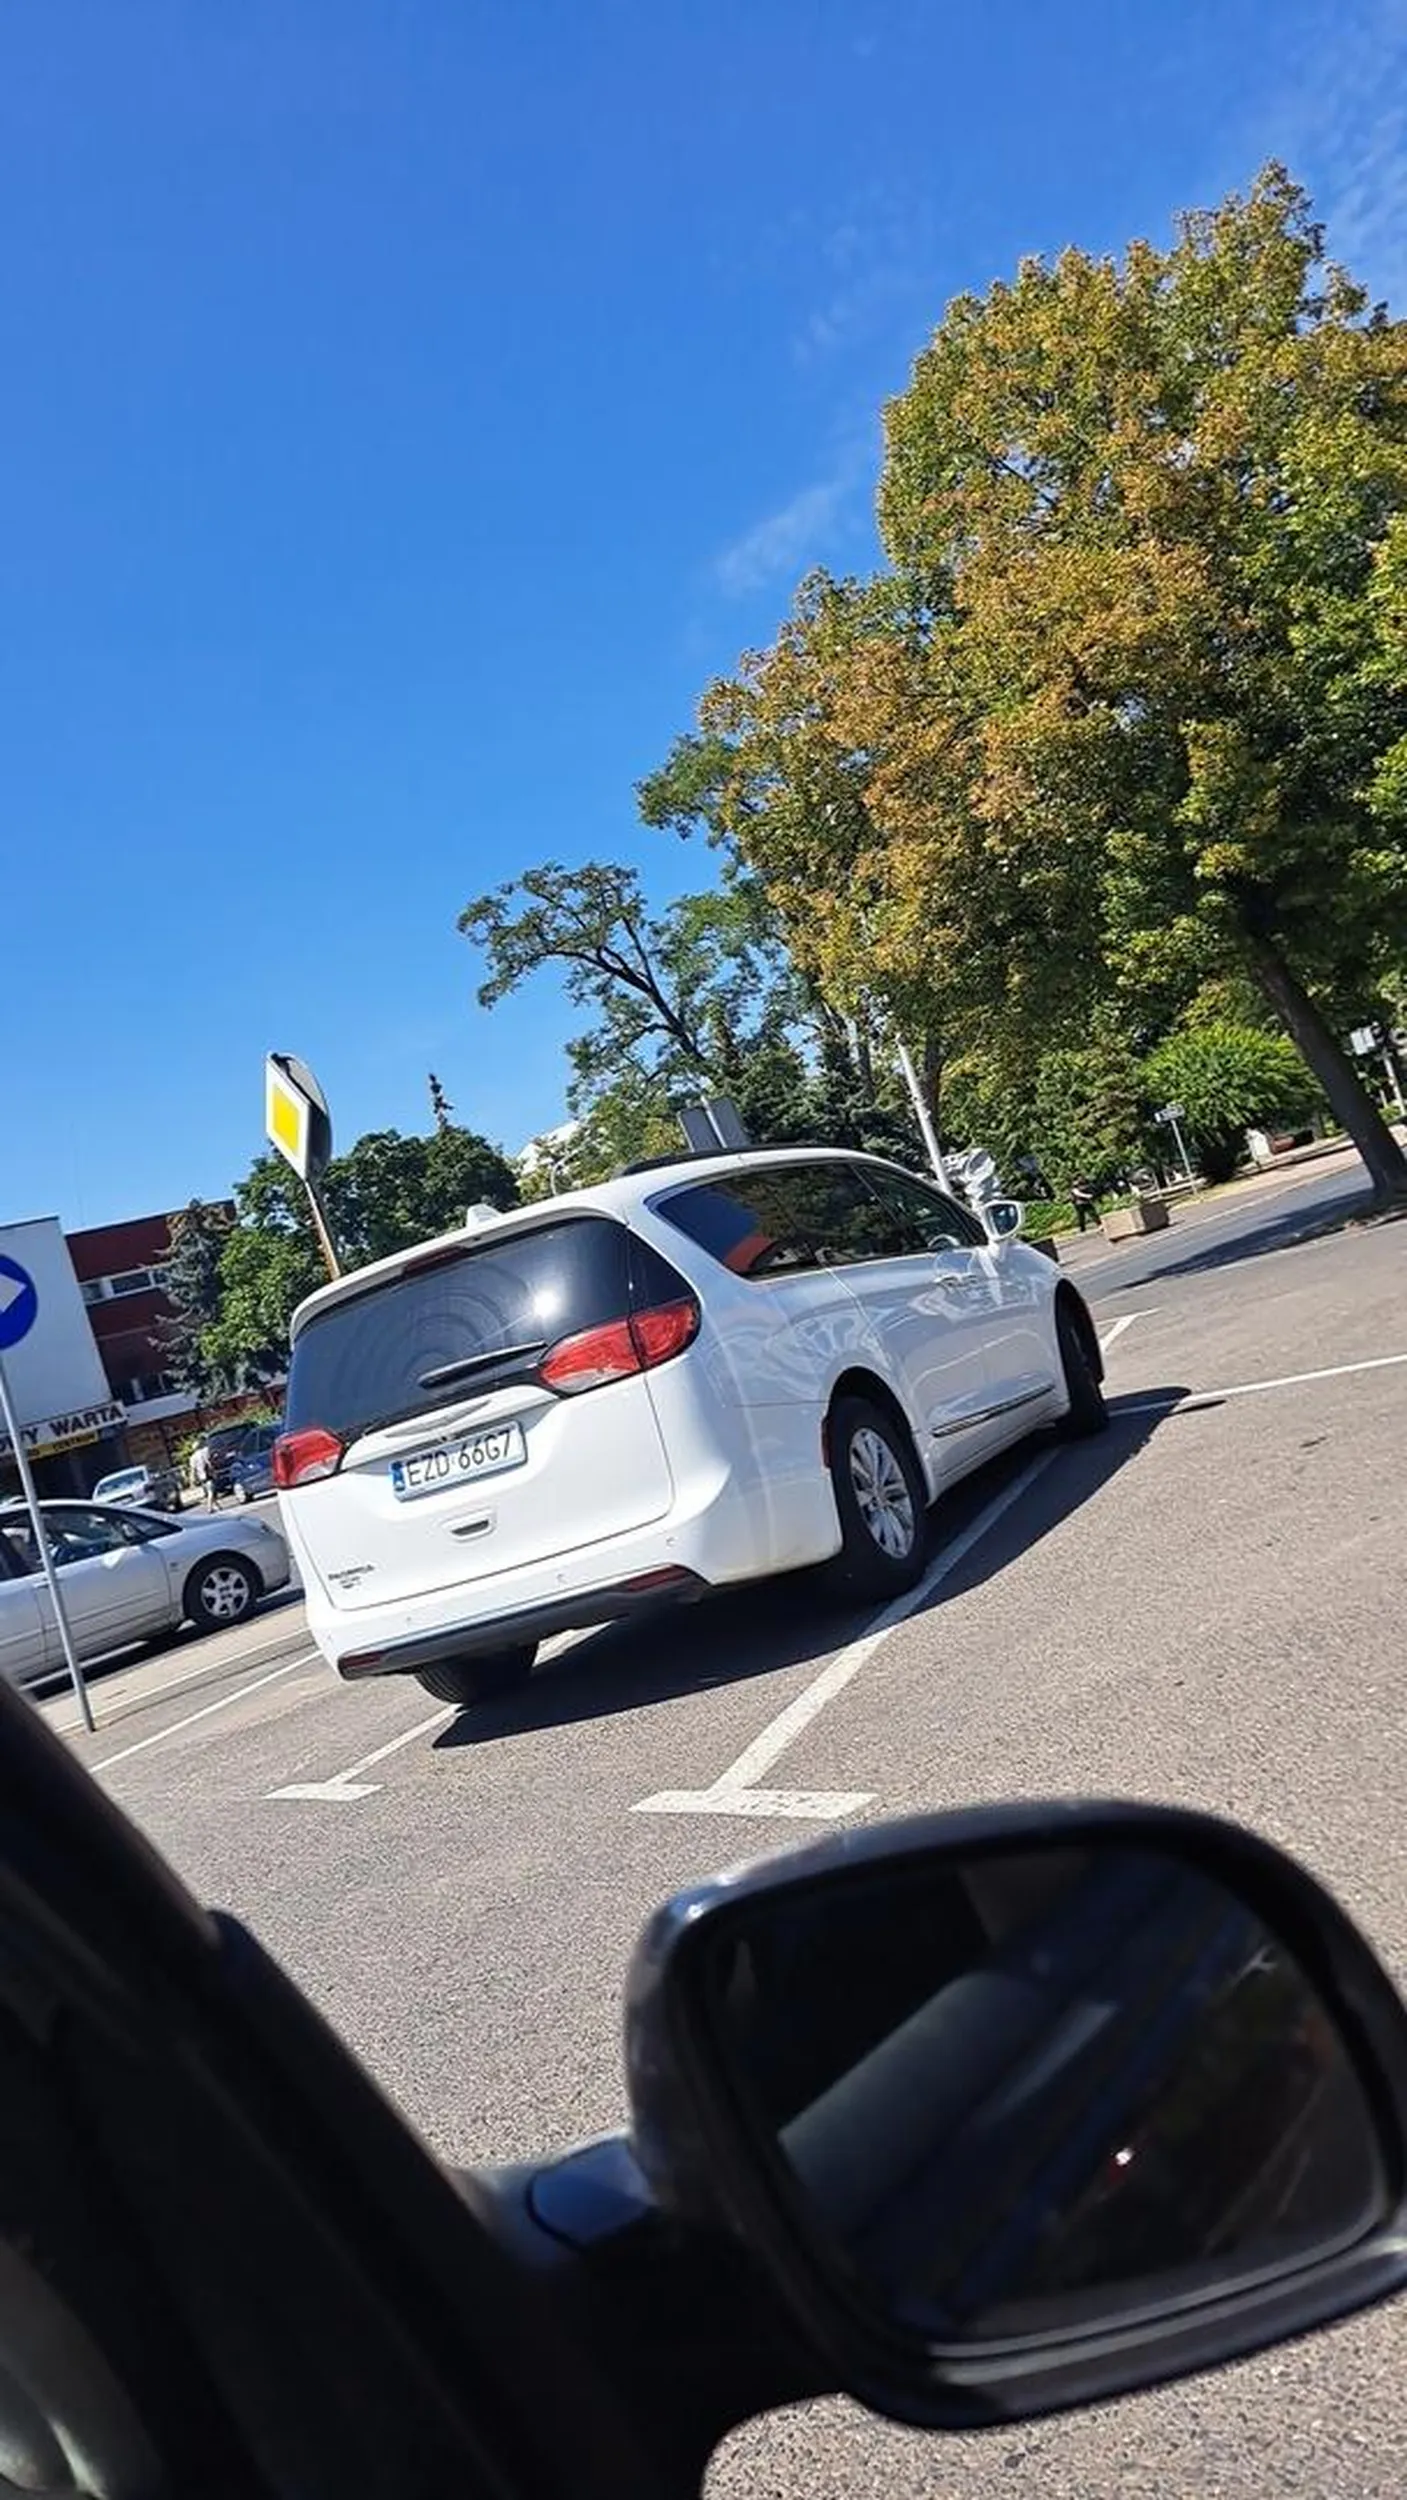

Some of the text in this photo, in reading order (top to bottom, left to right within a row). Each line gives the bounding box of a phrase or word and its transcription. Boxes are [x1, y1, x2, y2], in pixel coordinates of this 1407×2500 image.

[48, 1404, 123, 1437] WARTA
[406, 1429, 511, 1486] EZD 66G7
